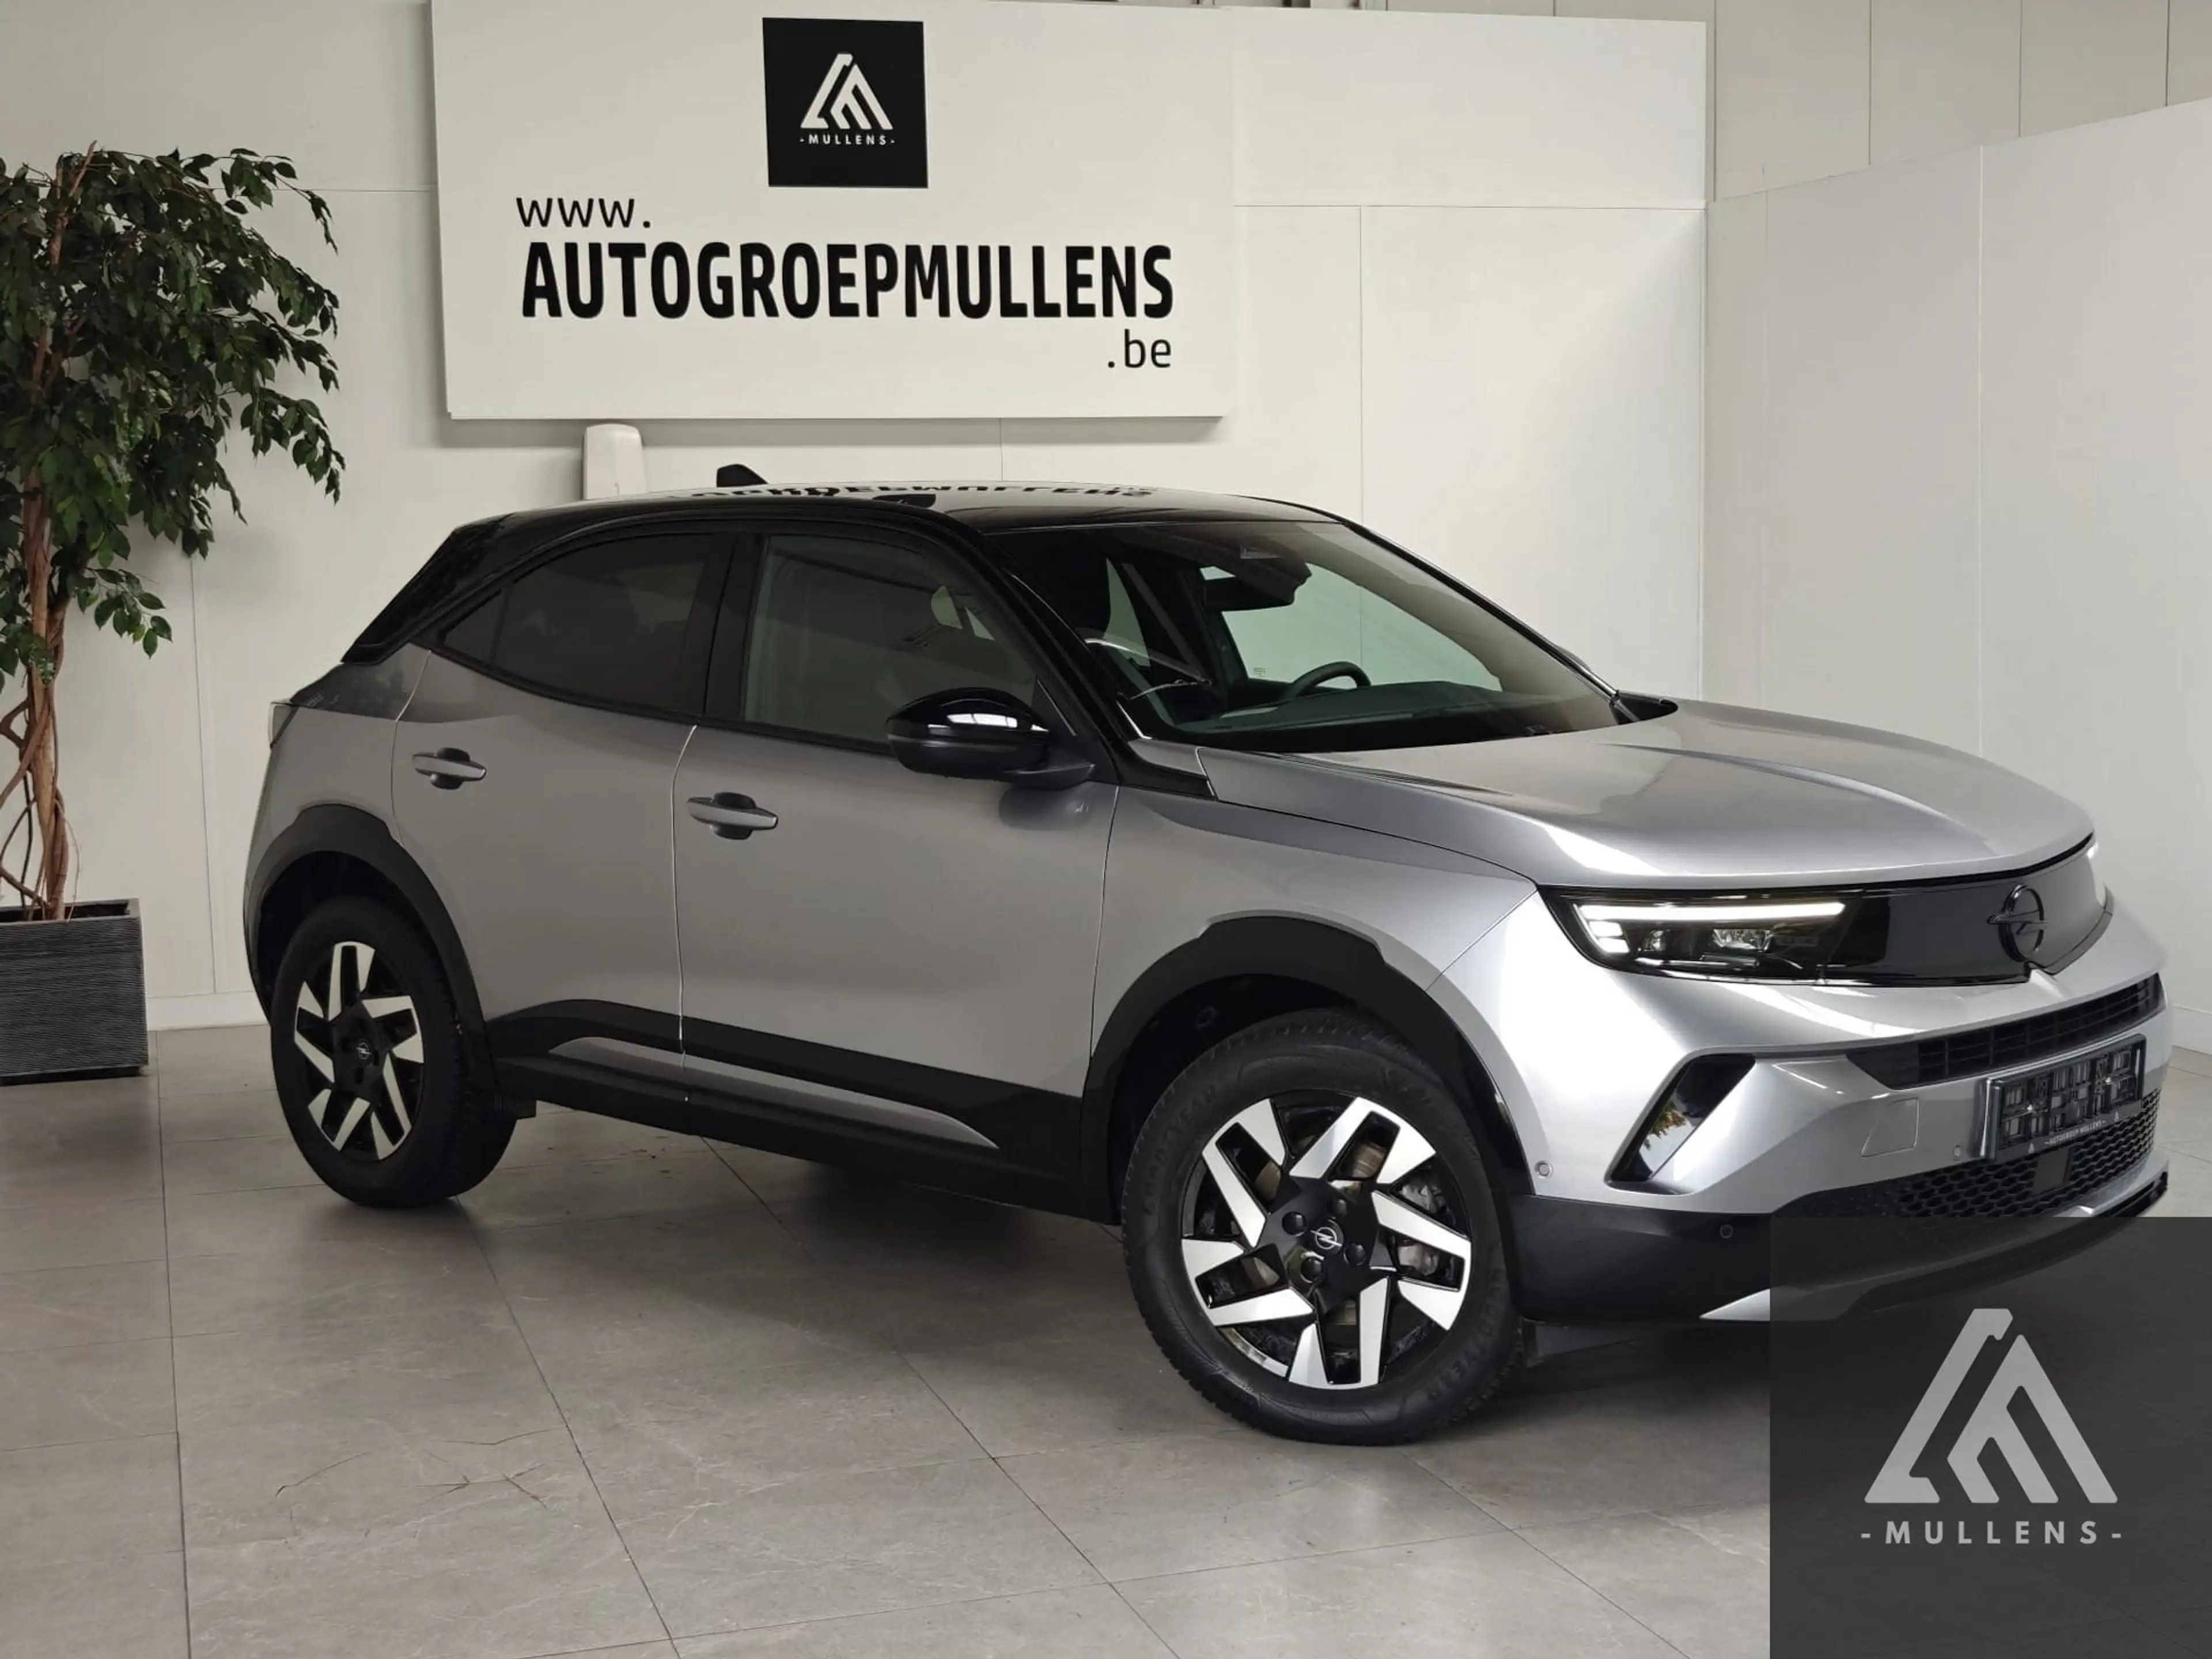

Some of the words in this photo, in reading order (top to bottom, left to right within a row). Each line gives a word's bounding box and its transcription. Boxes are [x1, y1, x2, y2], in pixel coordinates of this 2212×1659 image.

[516, 198, 650, 228] www.
[523, 242, 1172, 319] AUTOGROEPMULLENS
[1108, 329, 1171, 368] .be
